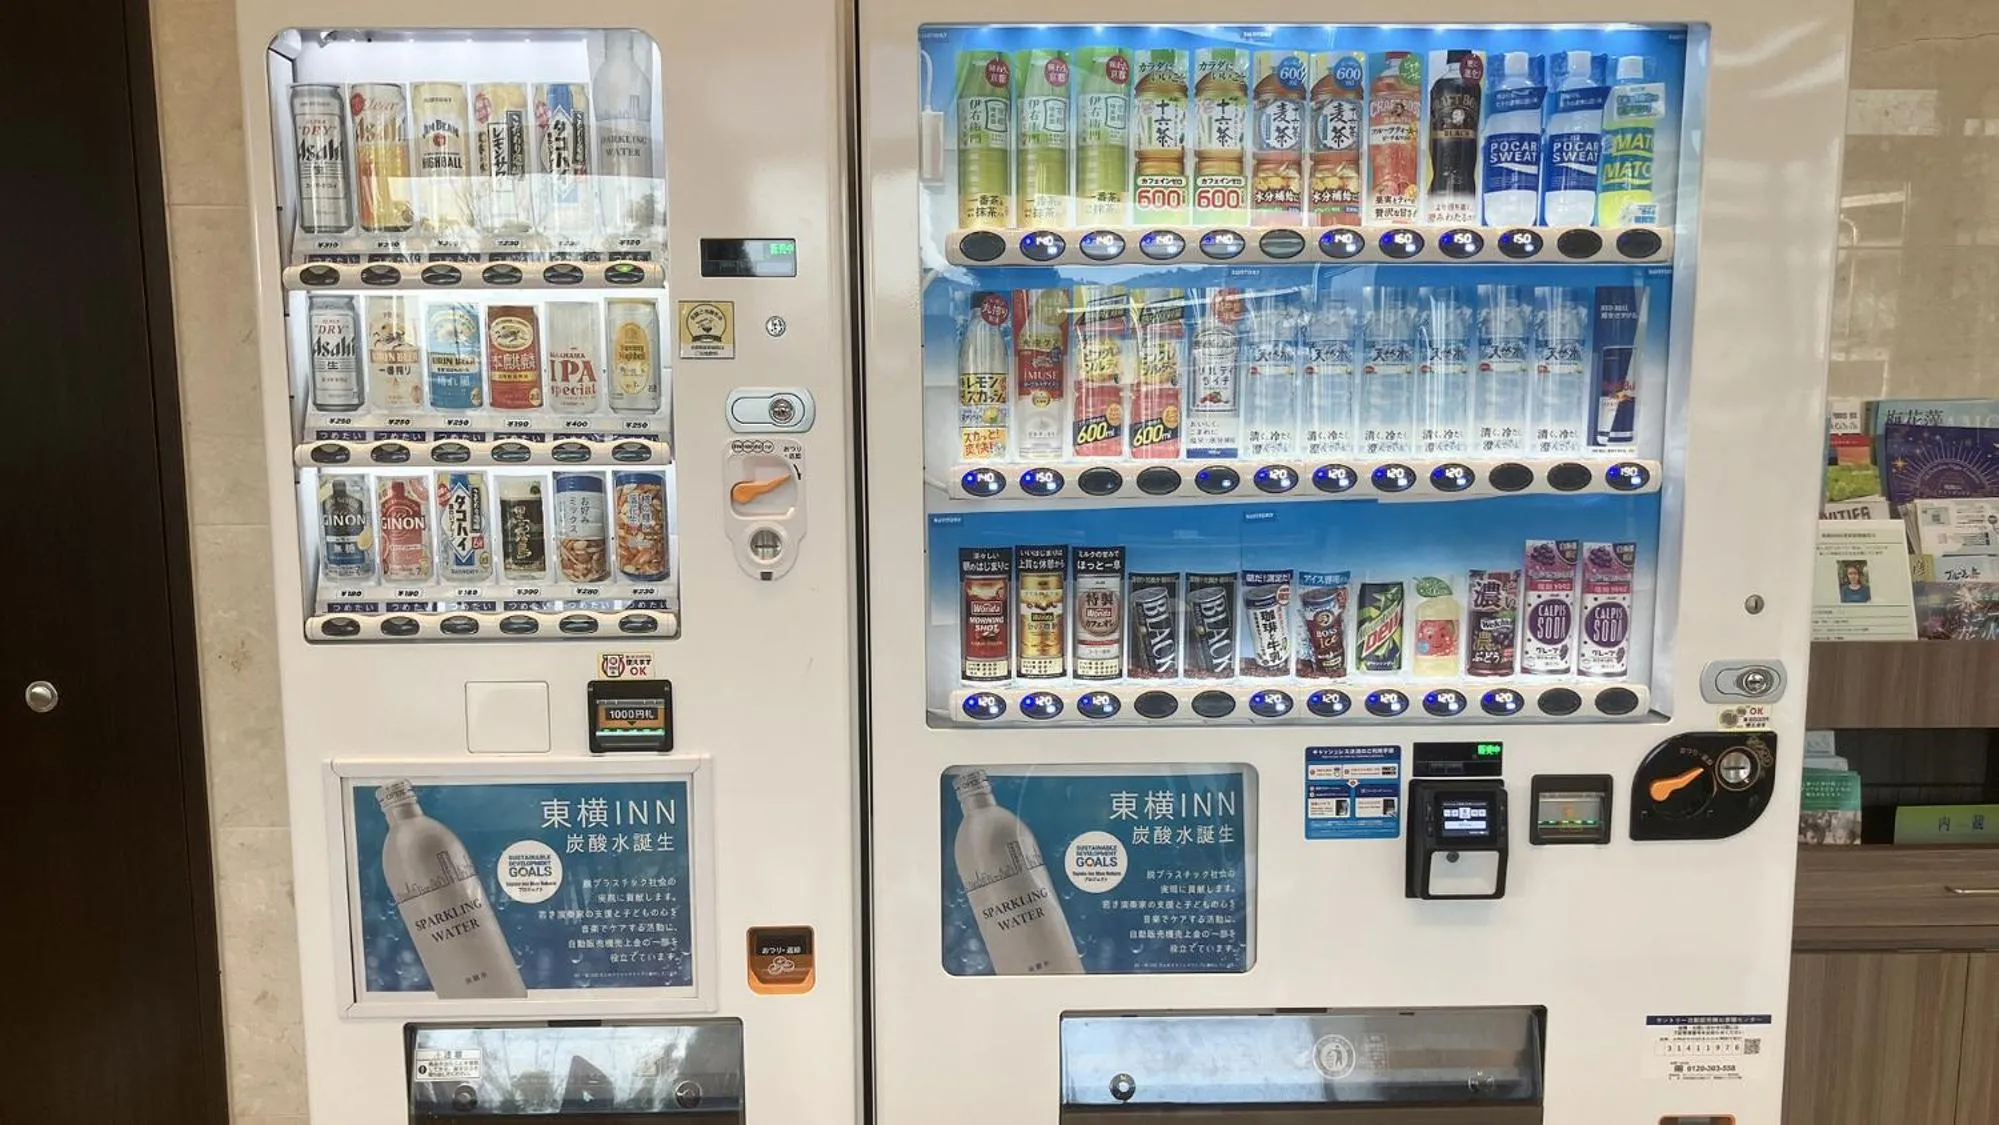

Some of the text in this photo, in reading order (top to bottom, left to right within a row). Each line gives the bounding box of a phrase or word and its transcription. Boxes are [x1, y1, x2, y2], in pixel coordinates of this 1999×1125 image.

[1336, 68, 1361, 80] 600
[1154, 99, 1174, 148] 十六茶
[1214, 99, 1234, 148] 十六茶
[1272, 102, 1294, 148] 麦茶
[1329, 102, 1351, 148] 麦茶
[422, 156, 463, 169] HIGHBALL
[492, 126, 508, 186] レモンサワ
[1489, 152, 1537, 164] SWEAT
[1552, 152, 1599, 164] SWEAT
[1141, 177, 1183, 186] カフェインゼロ
[1201, 177, 1243, 186] カフェインゼロ
[1137, 189, 1182, 209] 600
[1197, 189, 1242, 209] 600
[317, 324, 345, 335] DRY
[313, 336, 356, 357] Asahi
[551, 359, 597, 382] IPA
[967, 376, 999, 390] レモン
[329, 417, 353, 425] ¥250
[564, 420, 589, 428] ¥400
[1078, 424, 1107, 444] 600
[1133, 424, 1164, 447] 600
[321, 514, 366, 527] GINON
[381, 516, 427, 530] GINON
[453, 494, 470, 552] タコハイ
[1077, 559, 1122, 571] ほっと一息
[1086, 592, 1114, 605] 特製
[969, 616, 1005, 624] MORNING
[1538, 604, 1566, 617] CALPIS
[1594, 607, 1622, 620] CALPIS
[974, 624, 1000, 633] SHOT
[1143, 597, 1176, 673] BLACK
[1200, 597, 1233, 673] BLACK
[1260, 610, 1283, 664] 珈琲と牛乳
[1537, 616, 1566, 640] SODA
[1594, 619, 1622, 643] SODA
[630, 666, 647, 676] OK
[609, 710, 655, 719] 1000円札
[1750, 706, 1764, 716] OK
[540, 797, 676, 829] 東横INN
[1109, 790, 1235, 820] 東横INN
[566, 832, 675, 853] 炭酸水誕生
[1132, 824, 1235, 845] 炭酸水誕生
[508, 866, 553, 878] GOALS
[1075, 856, 1118, 868] GOALS
[982, 887, 1050, 920] SPARKLING
[415, 897, 483, 932] SPARKLING
[998, 906, 1046, 932] WATER
[431, 918, 481, 944] WATER
